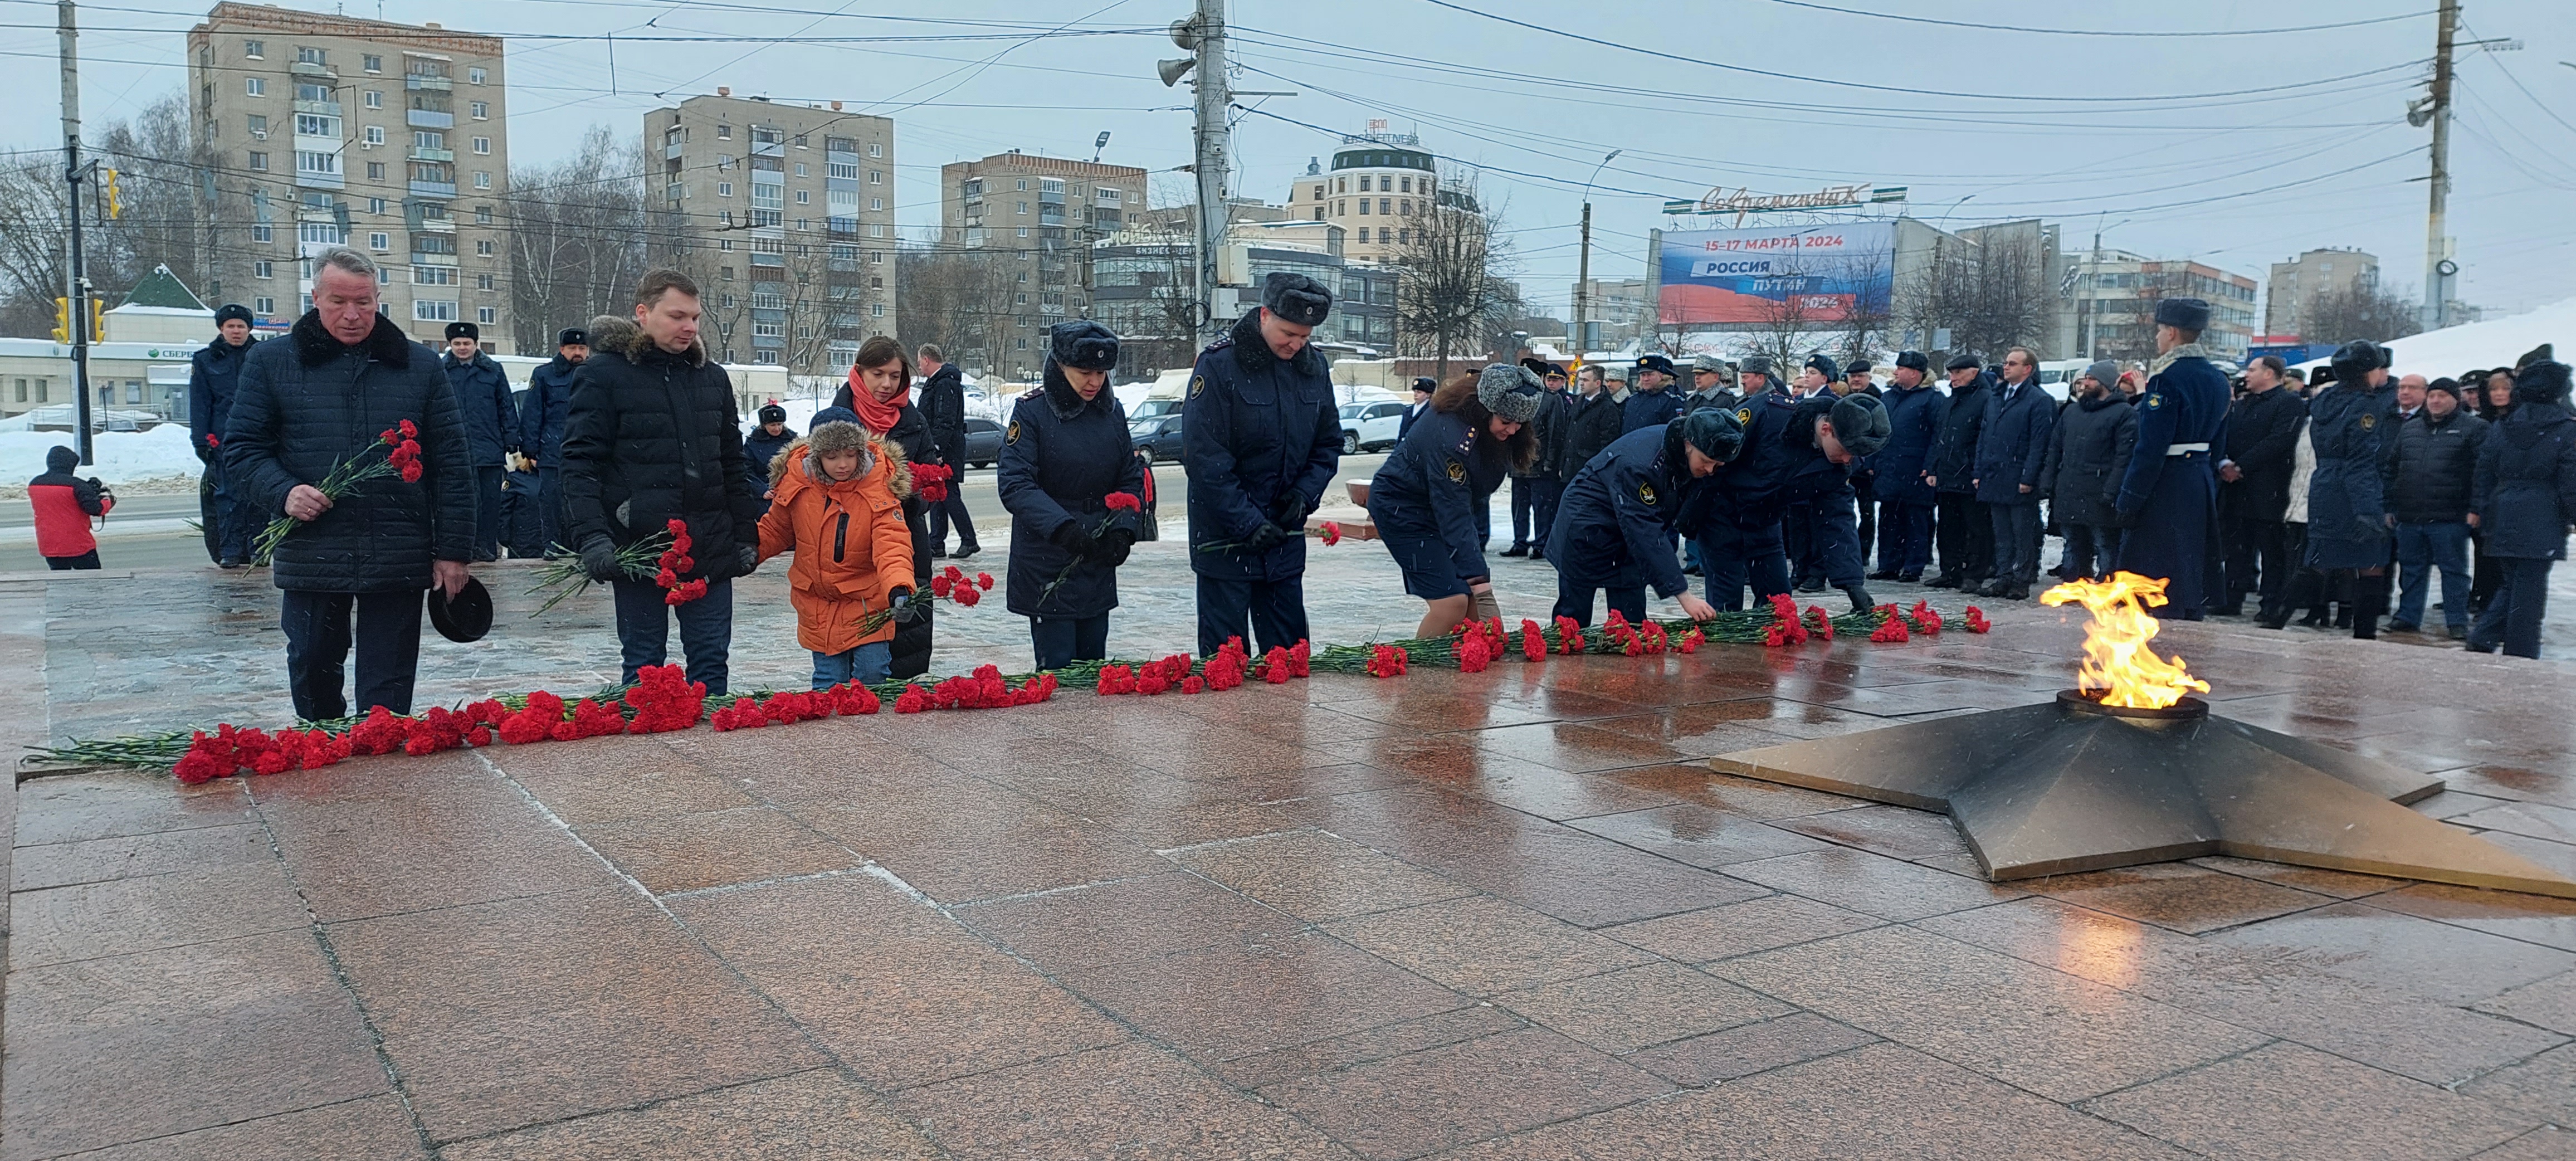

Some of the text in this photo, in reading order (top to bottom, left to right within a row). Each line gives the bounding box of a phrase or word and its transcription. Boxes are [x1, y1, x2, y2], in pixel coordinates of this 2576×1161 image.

[1700, 183, 1871, 229] Современник
[1745, 237, 1800, 250] МАРТА
[1805, 235, 1843, 247] 2024
[1706, 261, 1771, 274] РОССИЯ
[1753, 279, 1807, 291] ПУТИН
[1799, 296, 1838, 309] 2024
